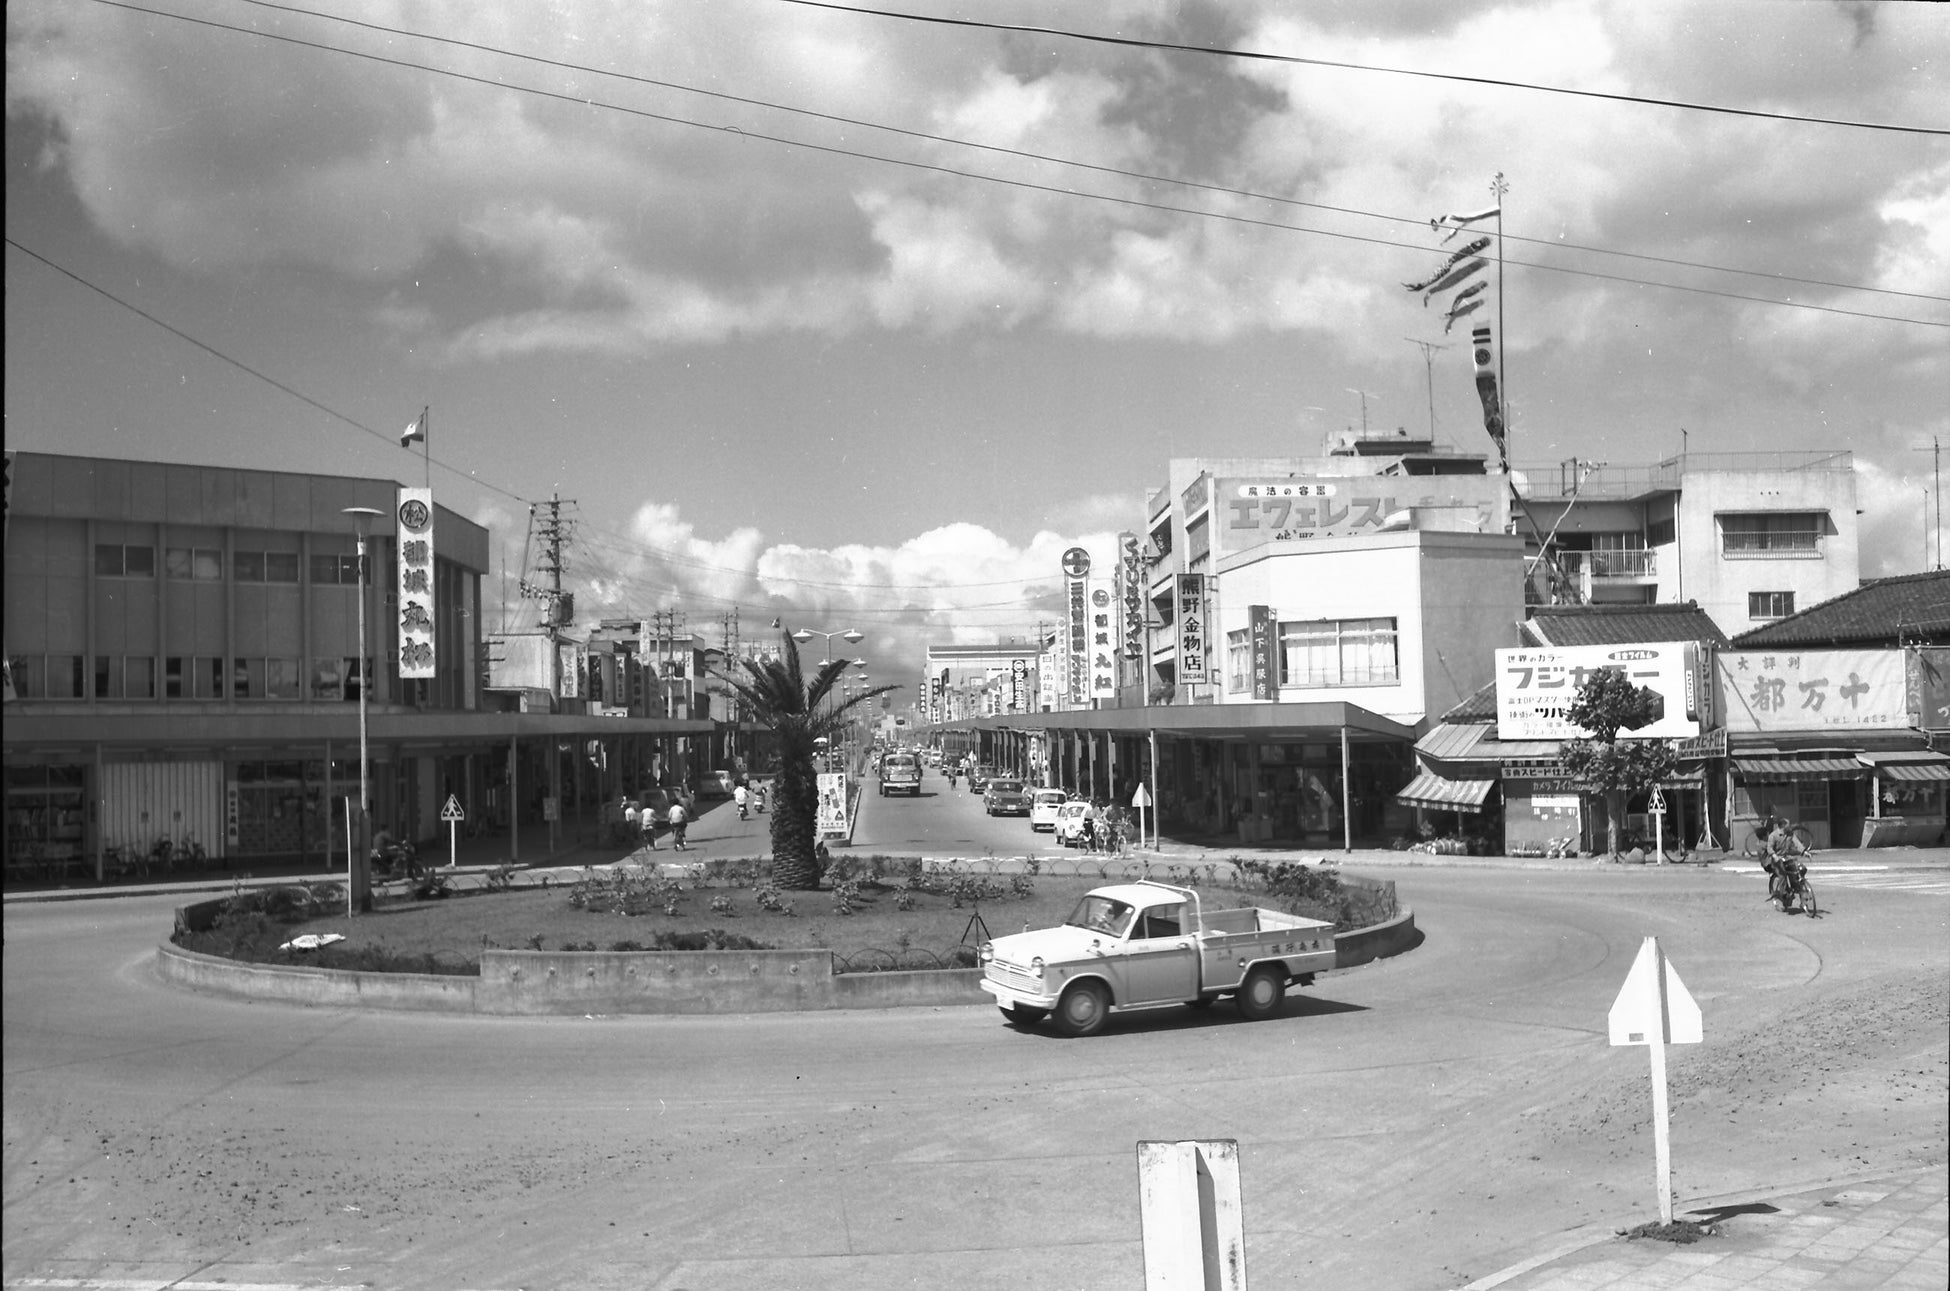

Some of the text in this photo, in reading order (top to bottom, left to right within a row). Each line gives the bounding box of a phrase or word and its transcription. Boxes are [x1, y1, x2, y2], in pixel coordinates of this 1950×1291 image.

[1248, 486, 1326, 496] 魔法の容器
[402, 541, 432, 672] 都城丸松
[1182, 578, 1202, 671] 熊野金物店
[1254, 622, 1267, 696] 山下呉服店
[1507, 653, 1564, 663] 世界のカラー
[1738, 656, 1800, 671] 大評判
[1750, 672, 1870, 712] 都万十
